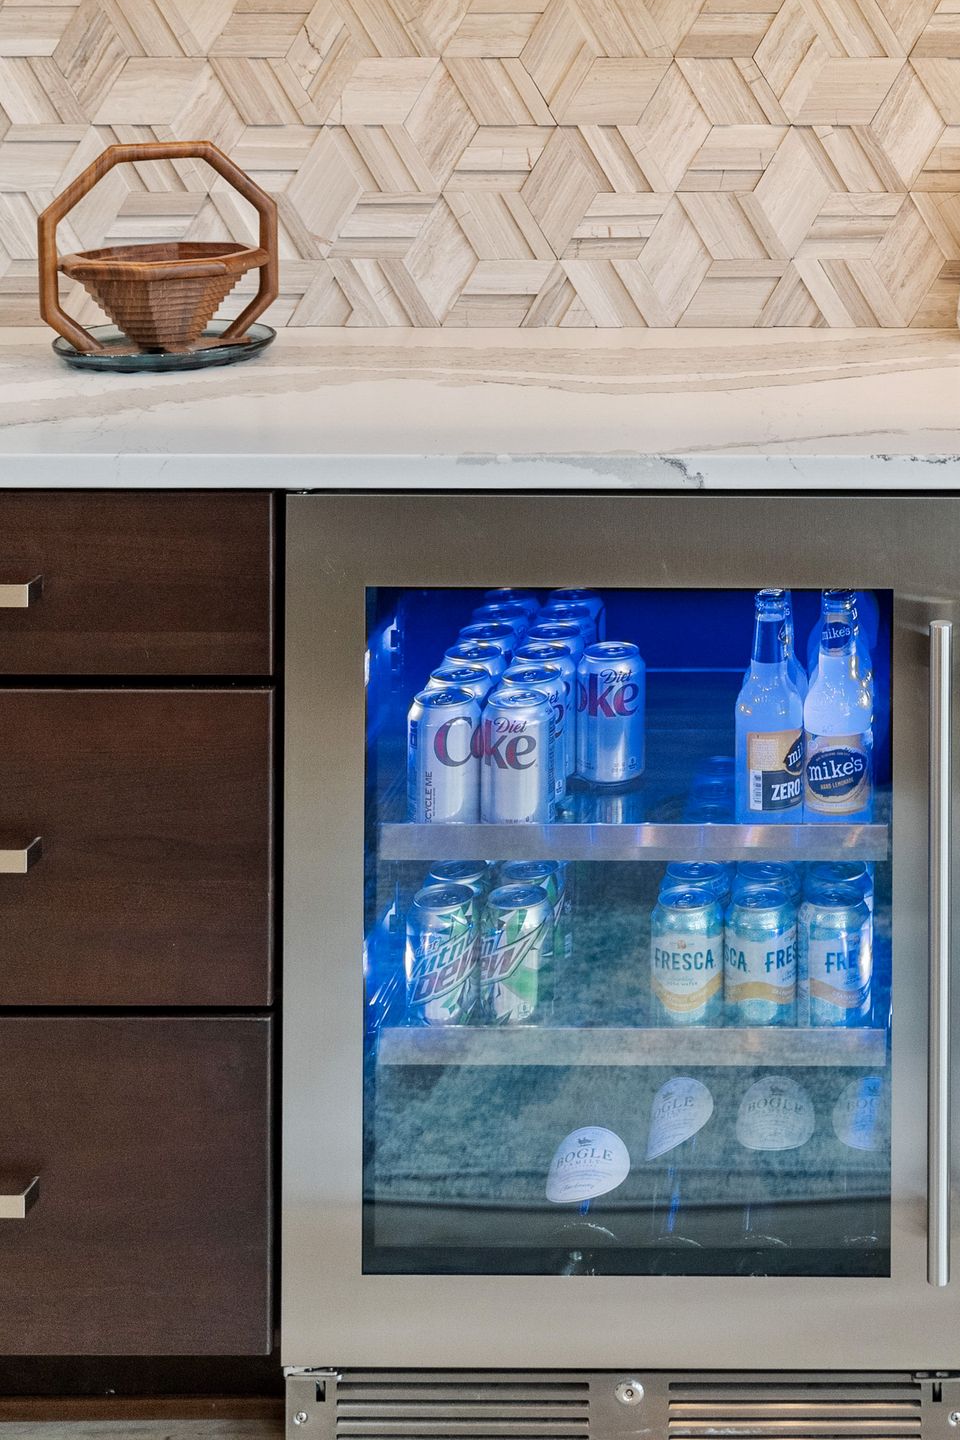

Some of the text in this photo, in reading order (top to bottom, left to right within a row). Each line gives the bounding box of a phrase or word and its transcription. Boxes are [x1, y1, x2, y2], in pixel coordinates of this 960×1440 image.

[600, 668, 633, 684] Diet
[493, 717, 527, 734] Diet
[809, 757, 864, 781] mike's
[771, 778, 801, 801] ZERO
[654, 947, 714, 971] FRESCA
[556, 1147, 614, 1169] BOGLE
